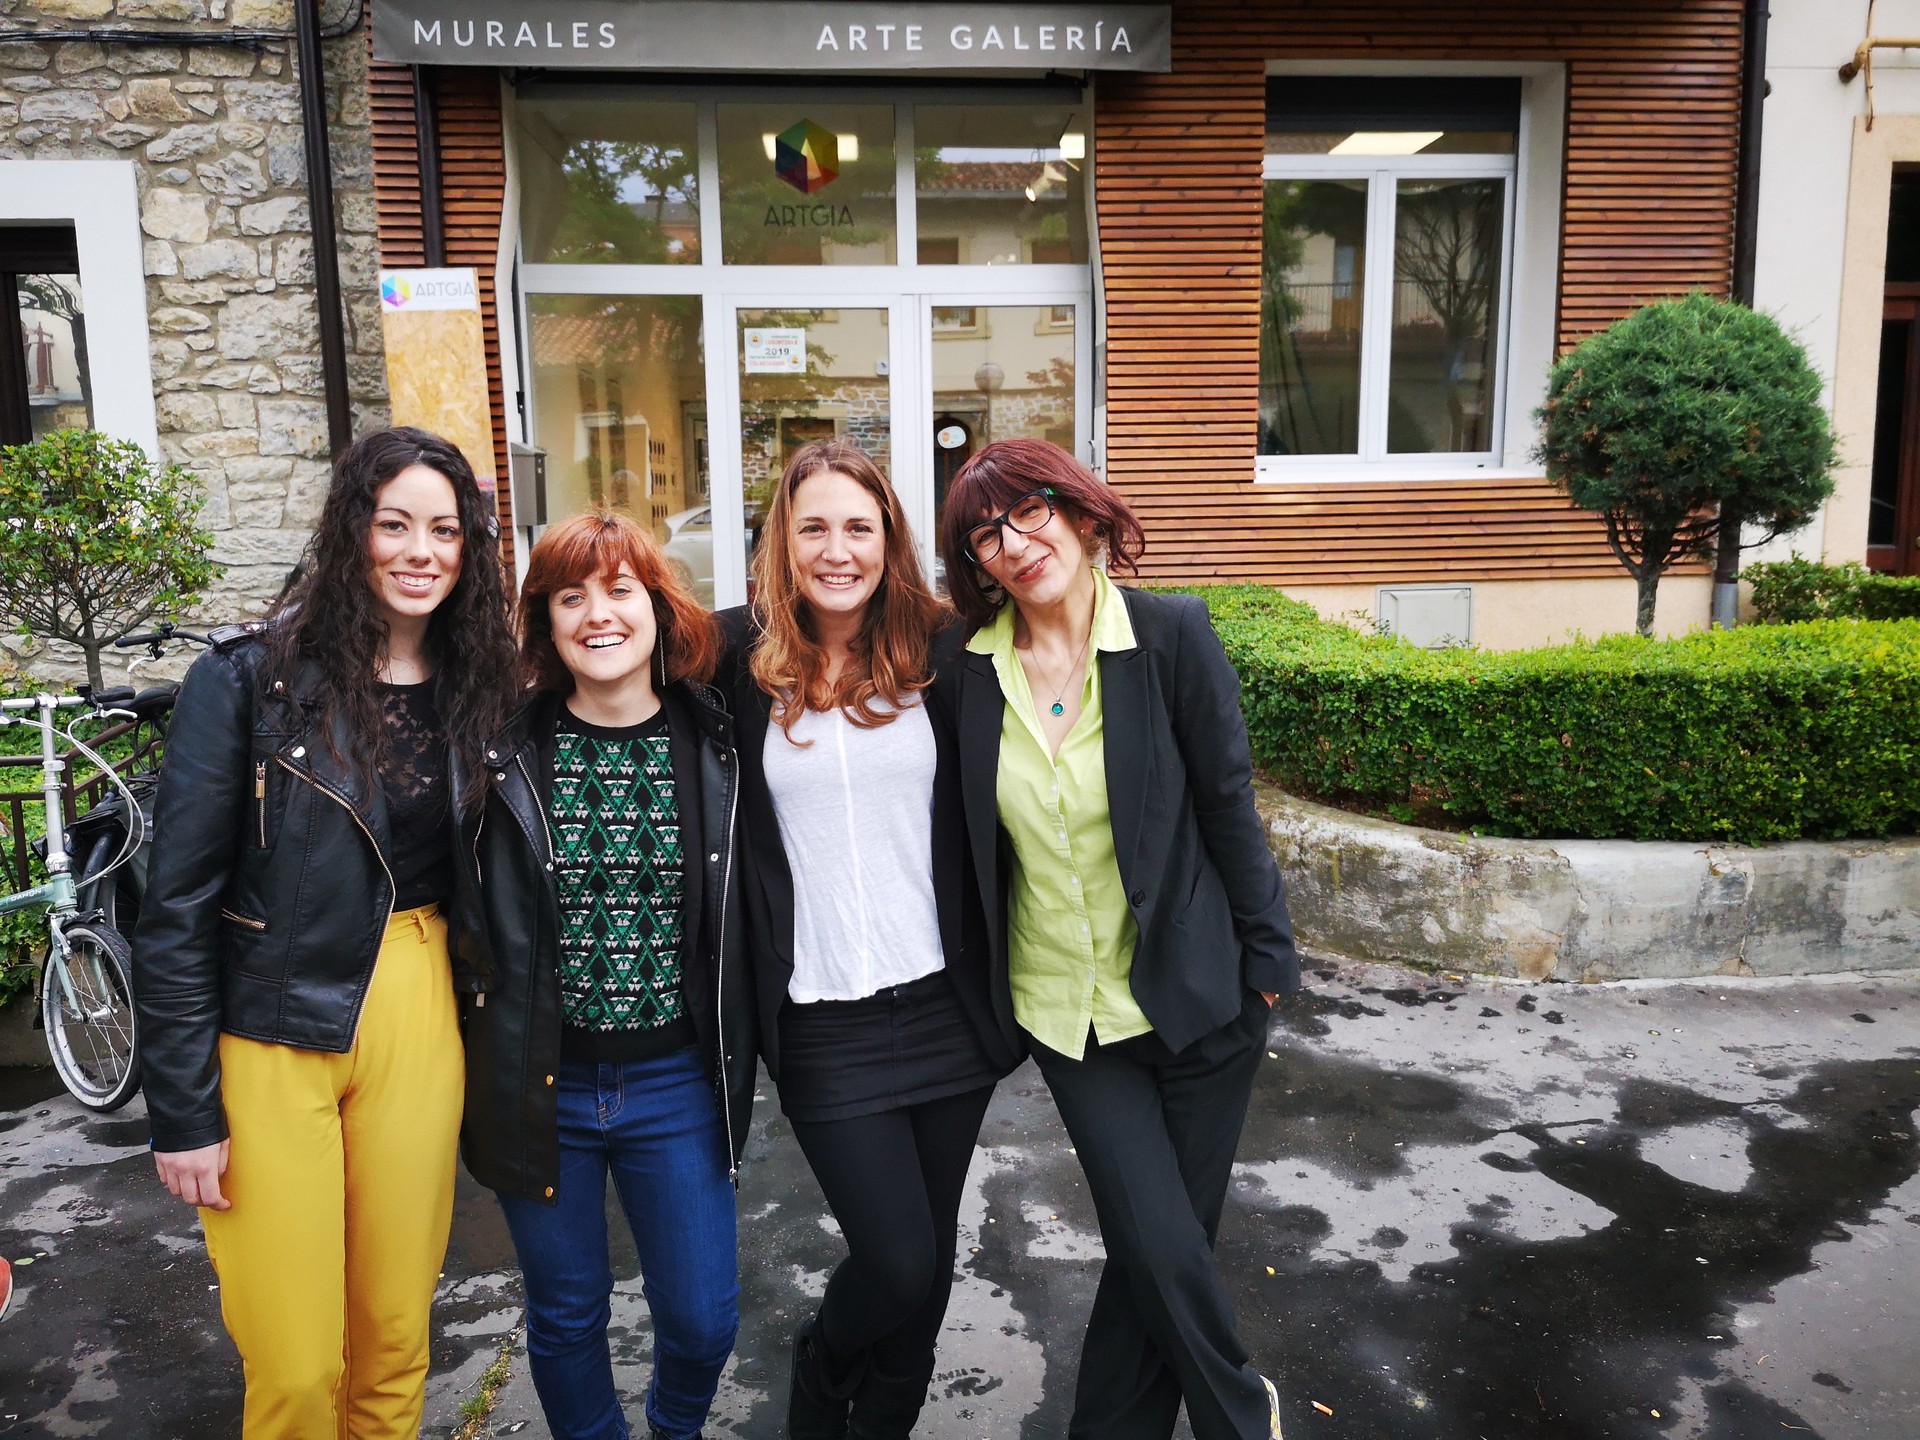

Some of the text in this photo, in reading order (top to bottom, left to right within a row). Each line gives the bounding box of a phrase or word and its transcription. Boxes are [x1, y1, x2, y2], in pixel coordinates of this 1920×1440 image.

[413, 19, 617, 49] MURALES
[815, 21, 1132, 53] ARTE GALERÍA
[763, 204, 855, 227] ARTGIA
[415, 281, 475, 297] ARTGIA
